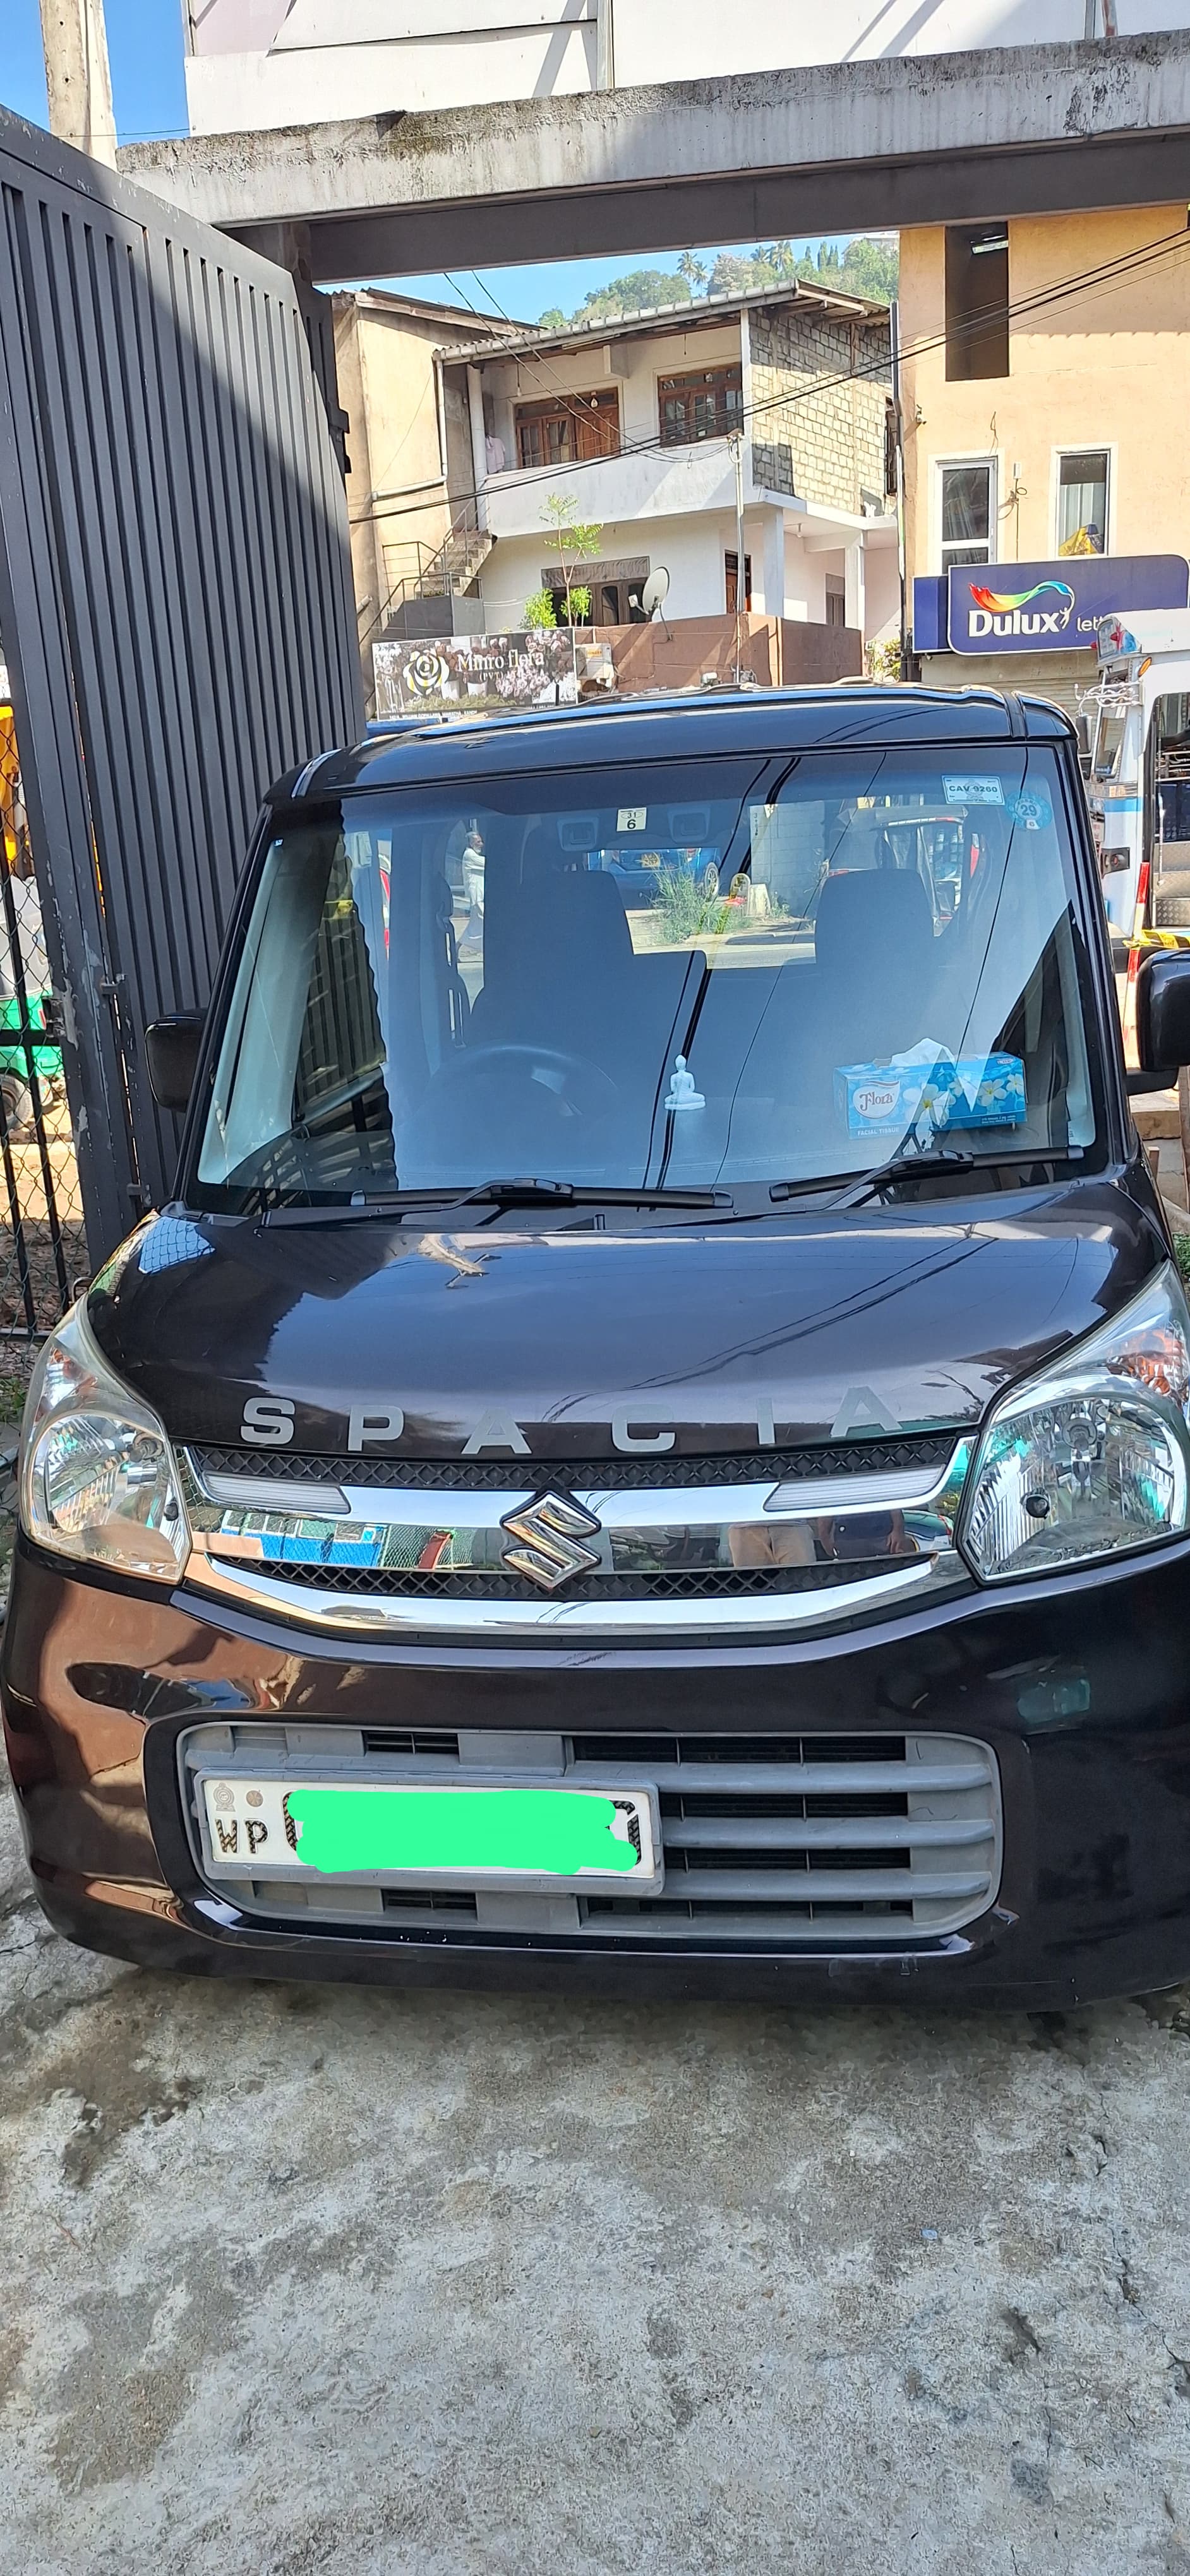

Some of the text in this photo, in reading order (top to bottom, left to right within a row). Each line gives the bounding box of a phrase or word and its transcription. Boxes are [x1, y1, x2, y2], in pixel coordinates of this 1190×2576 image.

[968, 609, 1060, 637] Dulux
[508, 649, 544, 667] flora
[479, 671, 503, 681] (PVT)
[1020, 804, 1038, 816] 29
[627, 819, 636, 830] 6
[859, 1091, 893, 1111] Flora
[240, 1387, 903, 1455] SPACIA
[215, 1818, 268, 1854] WP
